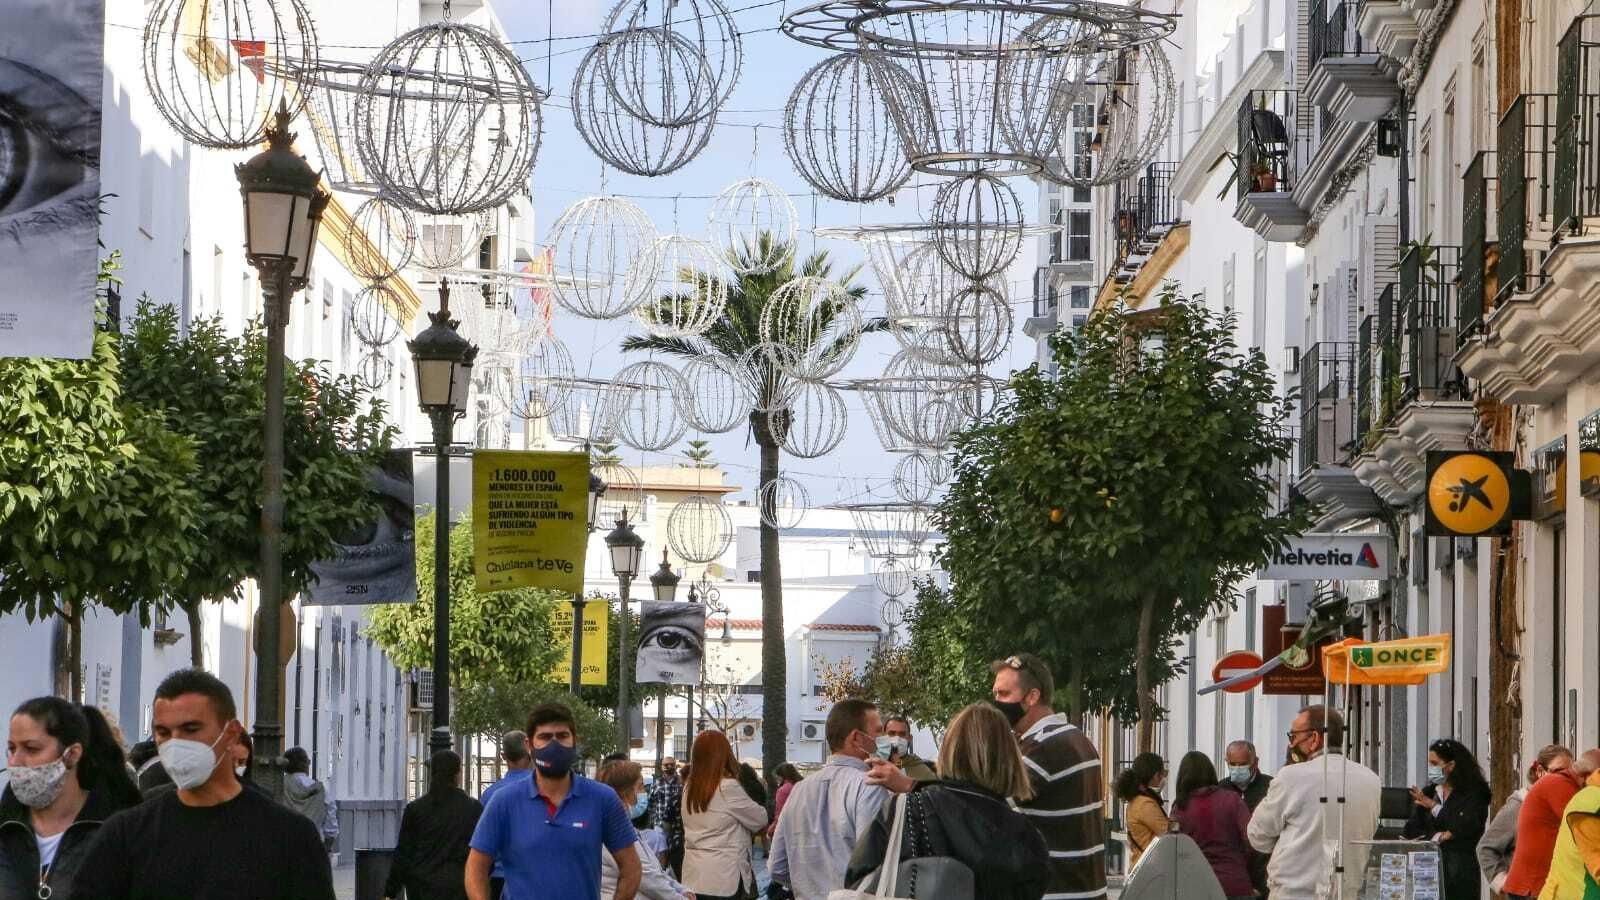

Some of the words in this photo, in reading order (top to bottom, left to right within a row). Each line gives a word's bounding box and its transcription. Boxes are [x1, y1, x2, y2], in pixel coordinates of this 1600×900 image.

[495, 469, 556, 482] 1.600.000
[488, 483, 524, 492] MENORES
[525, 483, 534, 492] EN
[535, 483, 564, 493] ESPAÑA
[489, 500, 504, 510] QUE
[505, 500, 514, 509] LA
[516, 500, 540, 510] MUJER
[488, 510, 529, 520] SUFRIENDO
[557, 511, 574, 521] TIPO
[488, 520, 498, 530] DE
[499, 520, 538, 530] VIOLENCIA
[1272, 547, 1354, 566] helvetia
[1377, 647, 1438, 664] ONCE
